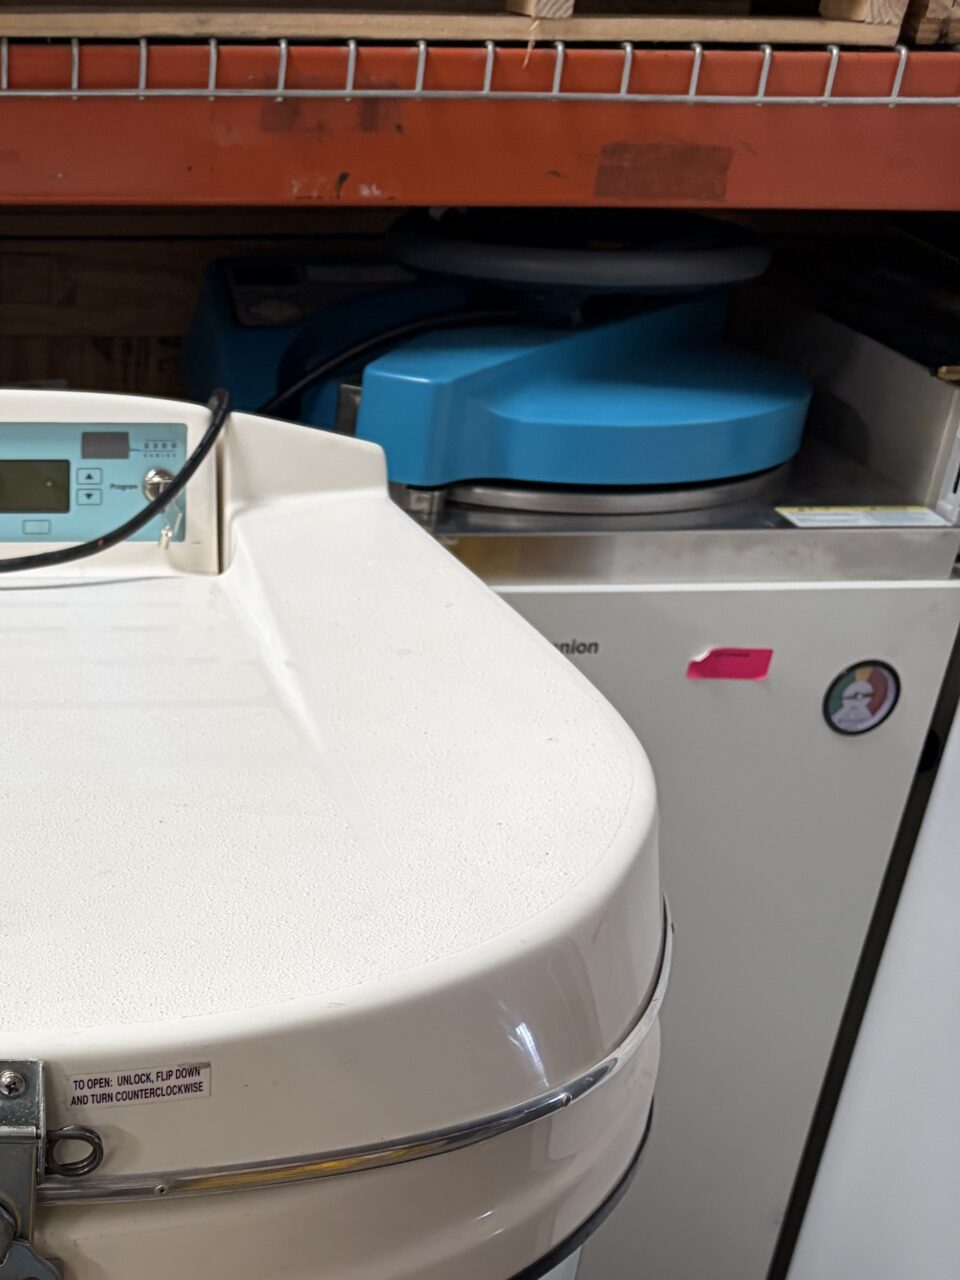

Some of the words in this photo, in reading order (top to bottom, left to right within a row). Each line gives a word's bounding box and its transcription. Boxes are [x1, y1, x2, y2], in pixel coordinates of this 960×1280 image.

[73, 1080, 85, 1091] TO
[87, 1077, 113, 1090] OPEN:
[117, 1072, 154, 1087] UNLOCK,
[156, 1070, 173, 1082] FLIP
[175, 1066, 201, 1080] DOWN
[71, 1095, 88, 1106] AND
[91, 1092, 113, 1104] TURN
[115, 1081, 204, 1103] COUNTERCLOCKWISE
